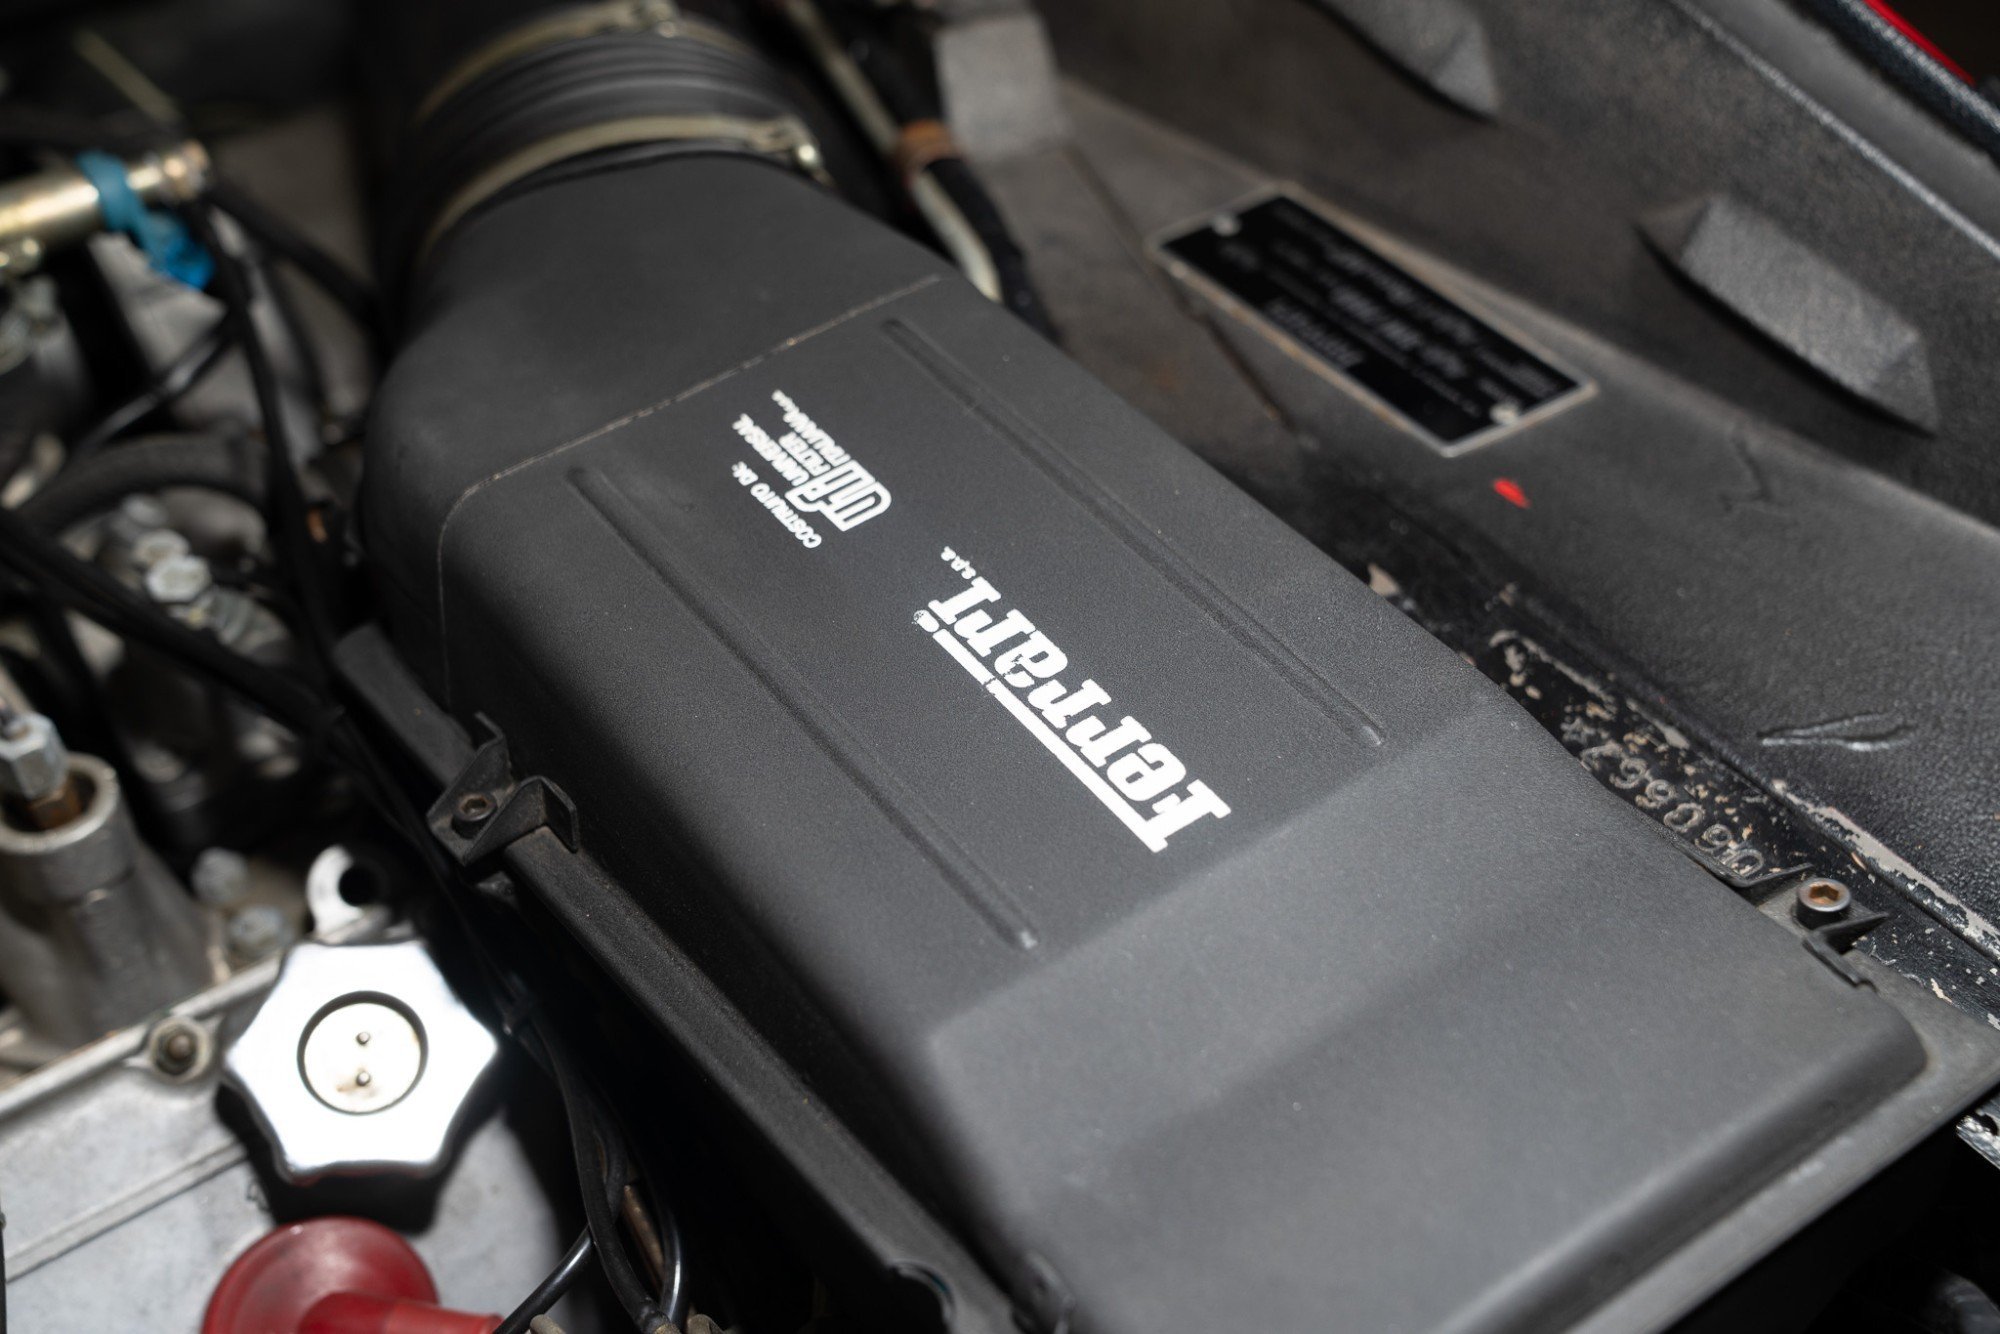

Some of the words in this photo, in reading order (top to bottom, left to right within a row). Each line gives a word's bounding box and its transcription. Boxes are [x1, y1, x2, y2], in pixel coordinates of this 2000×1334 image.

[732, 413, 810, 487] UNIVERSAL
[778, 431, 831, 477] FILTER
[751, 483, 822, 548] COSTRUITO
[912, 576, 1231, 853] Ferrari
